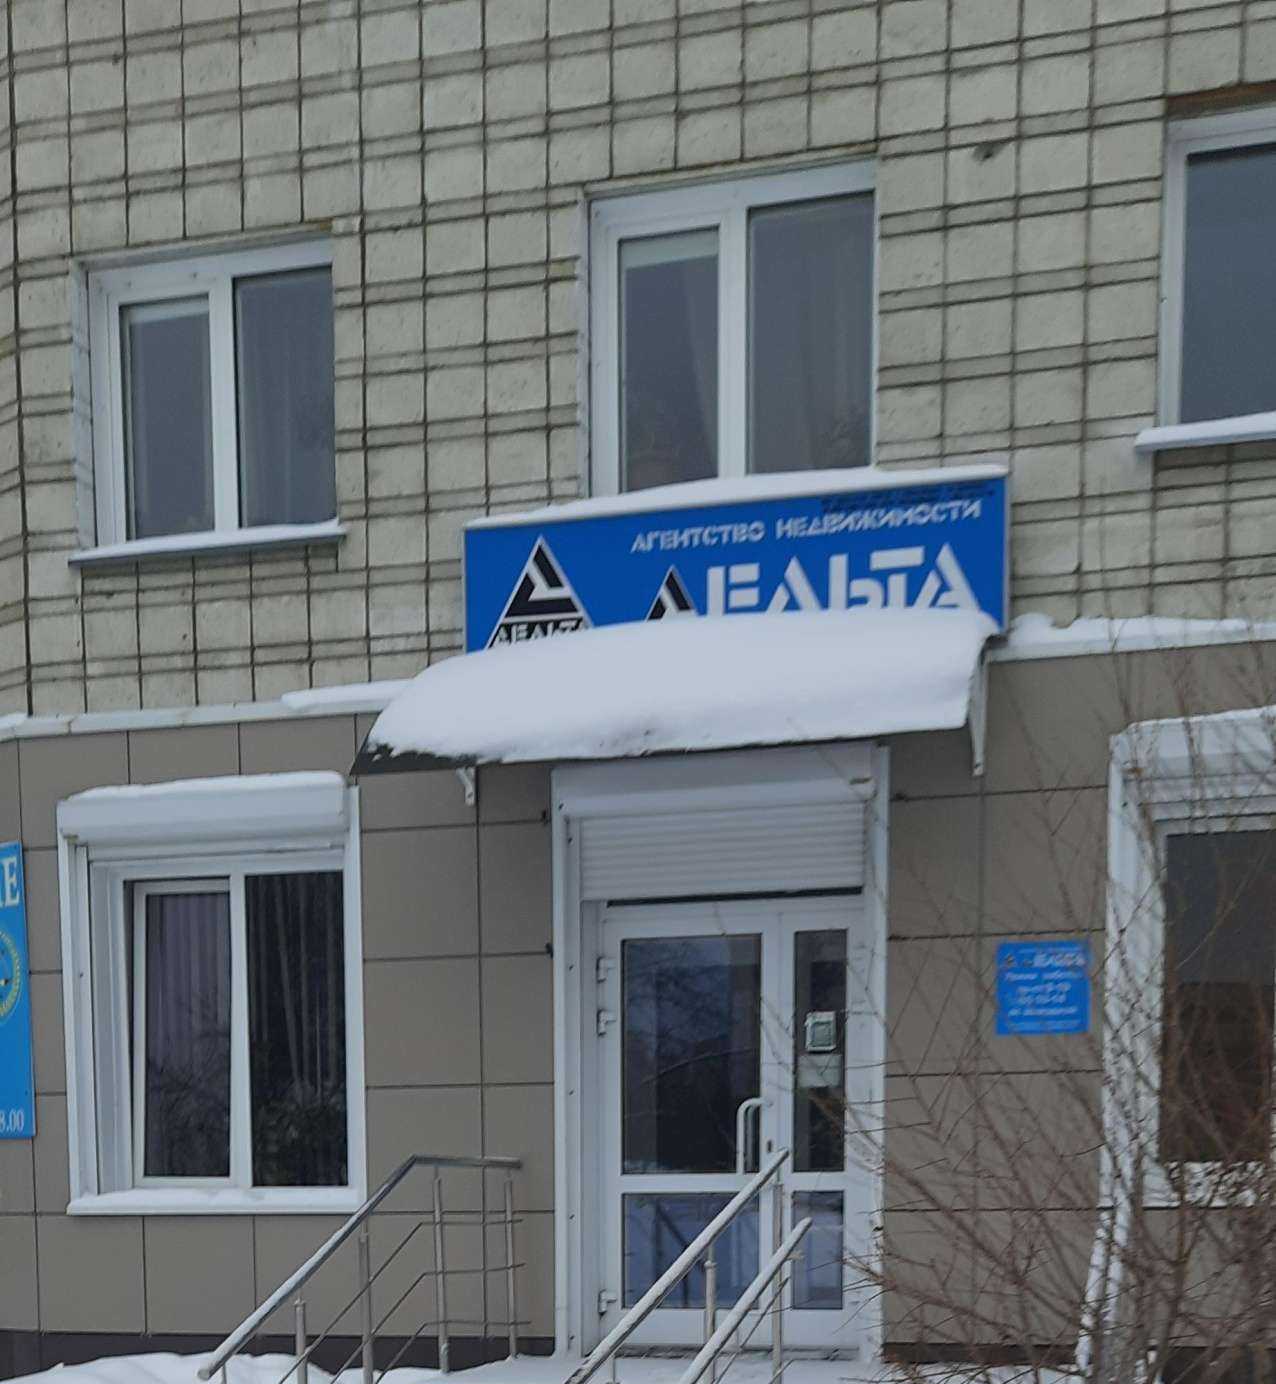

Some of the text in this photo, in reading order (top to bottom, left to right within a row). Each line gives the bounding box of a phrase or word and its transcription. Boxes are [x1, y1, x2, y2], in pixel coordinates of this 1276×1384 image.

[631, 499, 982, 553] АГЕНТСТВО НЕДВИЖИМОСТИ
[0, 855, 20, 908] Е
